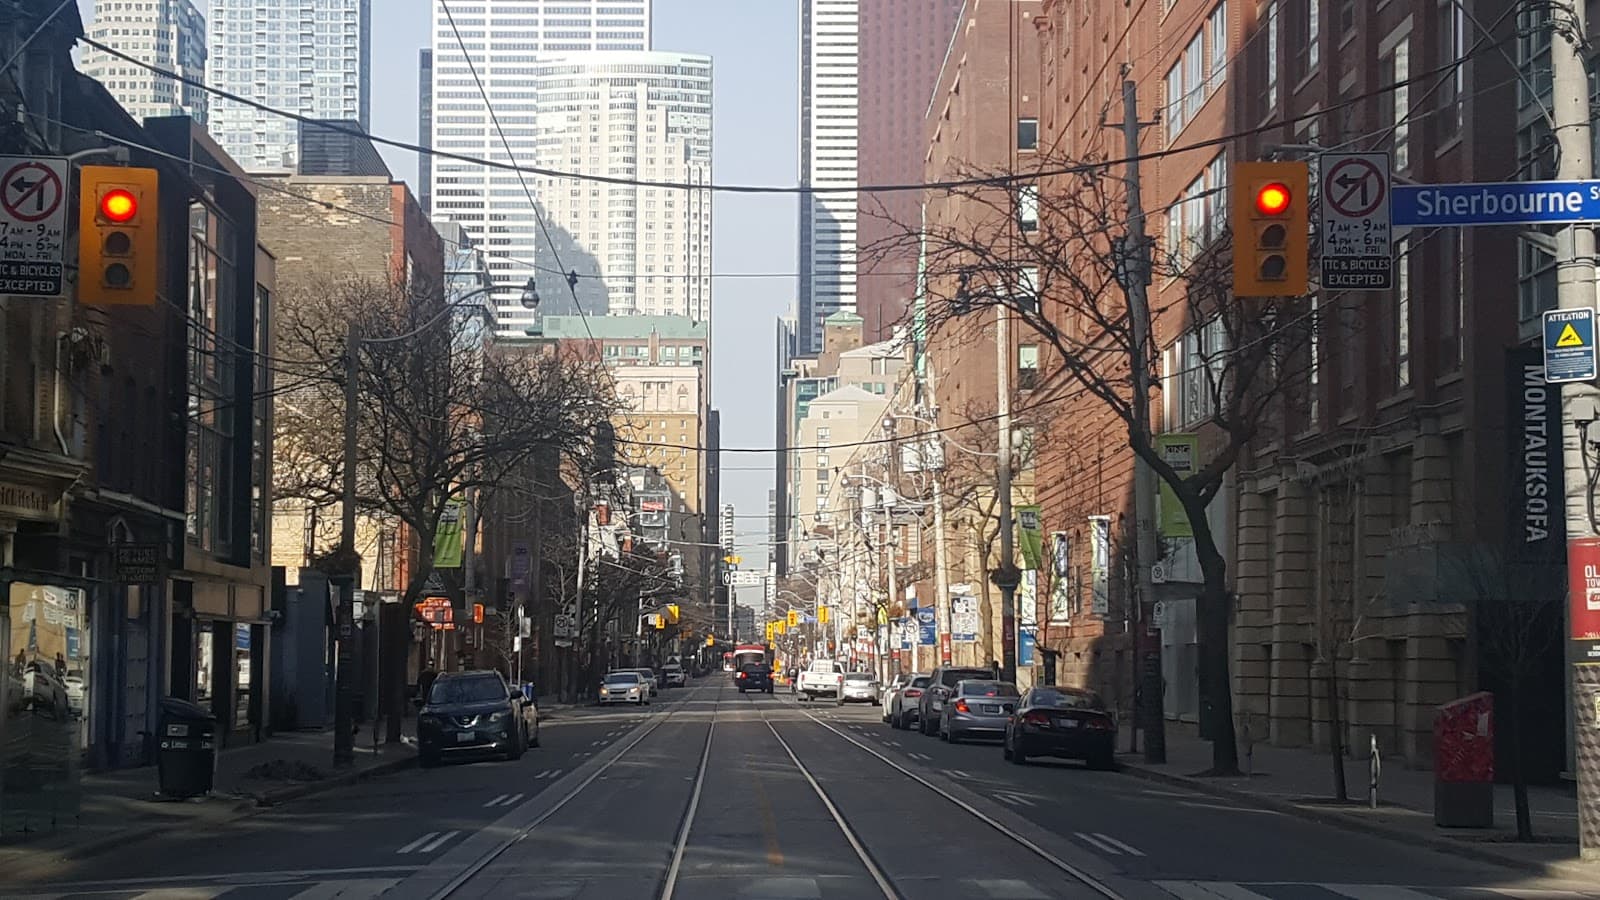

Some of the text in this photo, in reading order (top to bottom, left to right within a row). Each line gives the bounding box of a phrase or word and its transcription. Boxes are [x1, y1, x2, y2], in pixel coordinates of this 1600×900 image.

[1417, 185, 1600, 216] Sherbourne S
[4, 250, 26, 258] MON
[1334, 246, 1354, 254] MON
[19, 265, 60, 277] BICYCLES
[1324, 260, 1339, 270] TTC
[1350, 260, 1390, 271] BICYCLES
[1328, 274, 1384, 285] EXCEPTED
[0, 279, 55, 292] EXCEPTED
[1548, 311, 1589, 322] ATTENTION
[1523, 364, 1549, 544] MONTAUKSOFA
